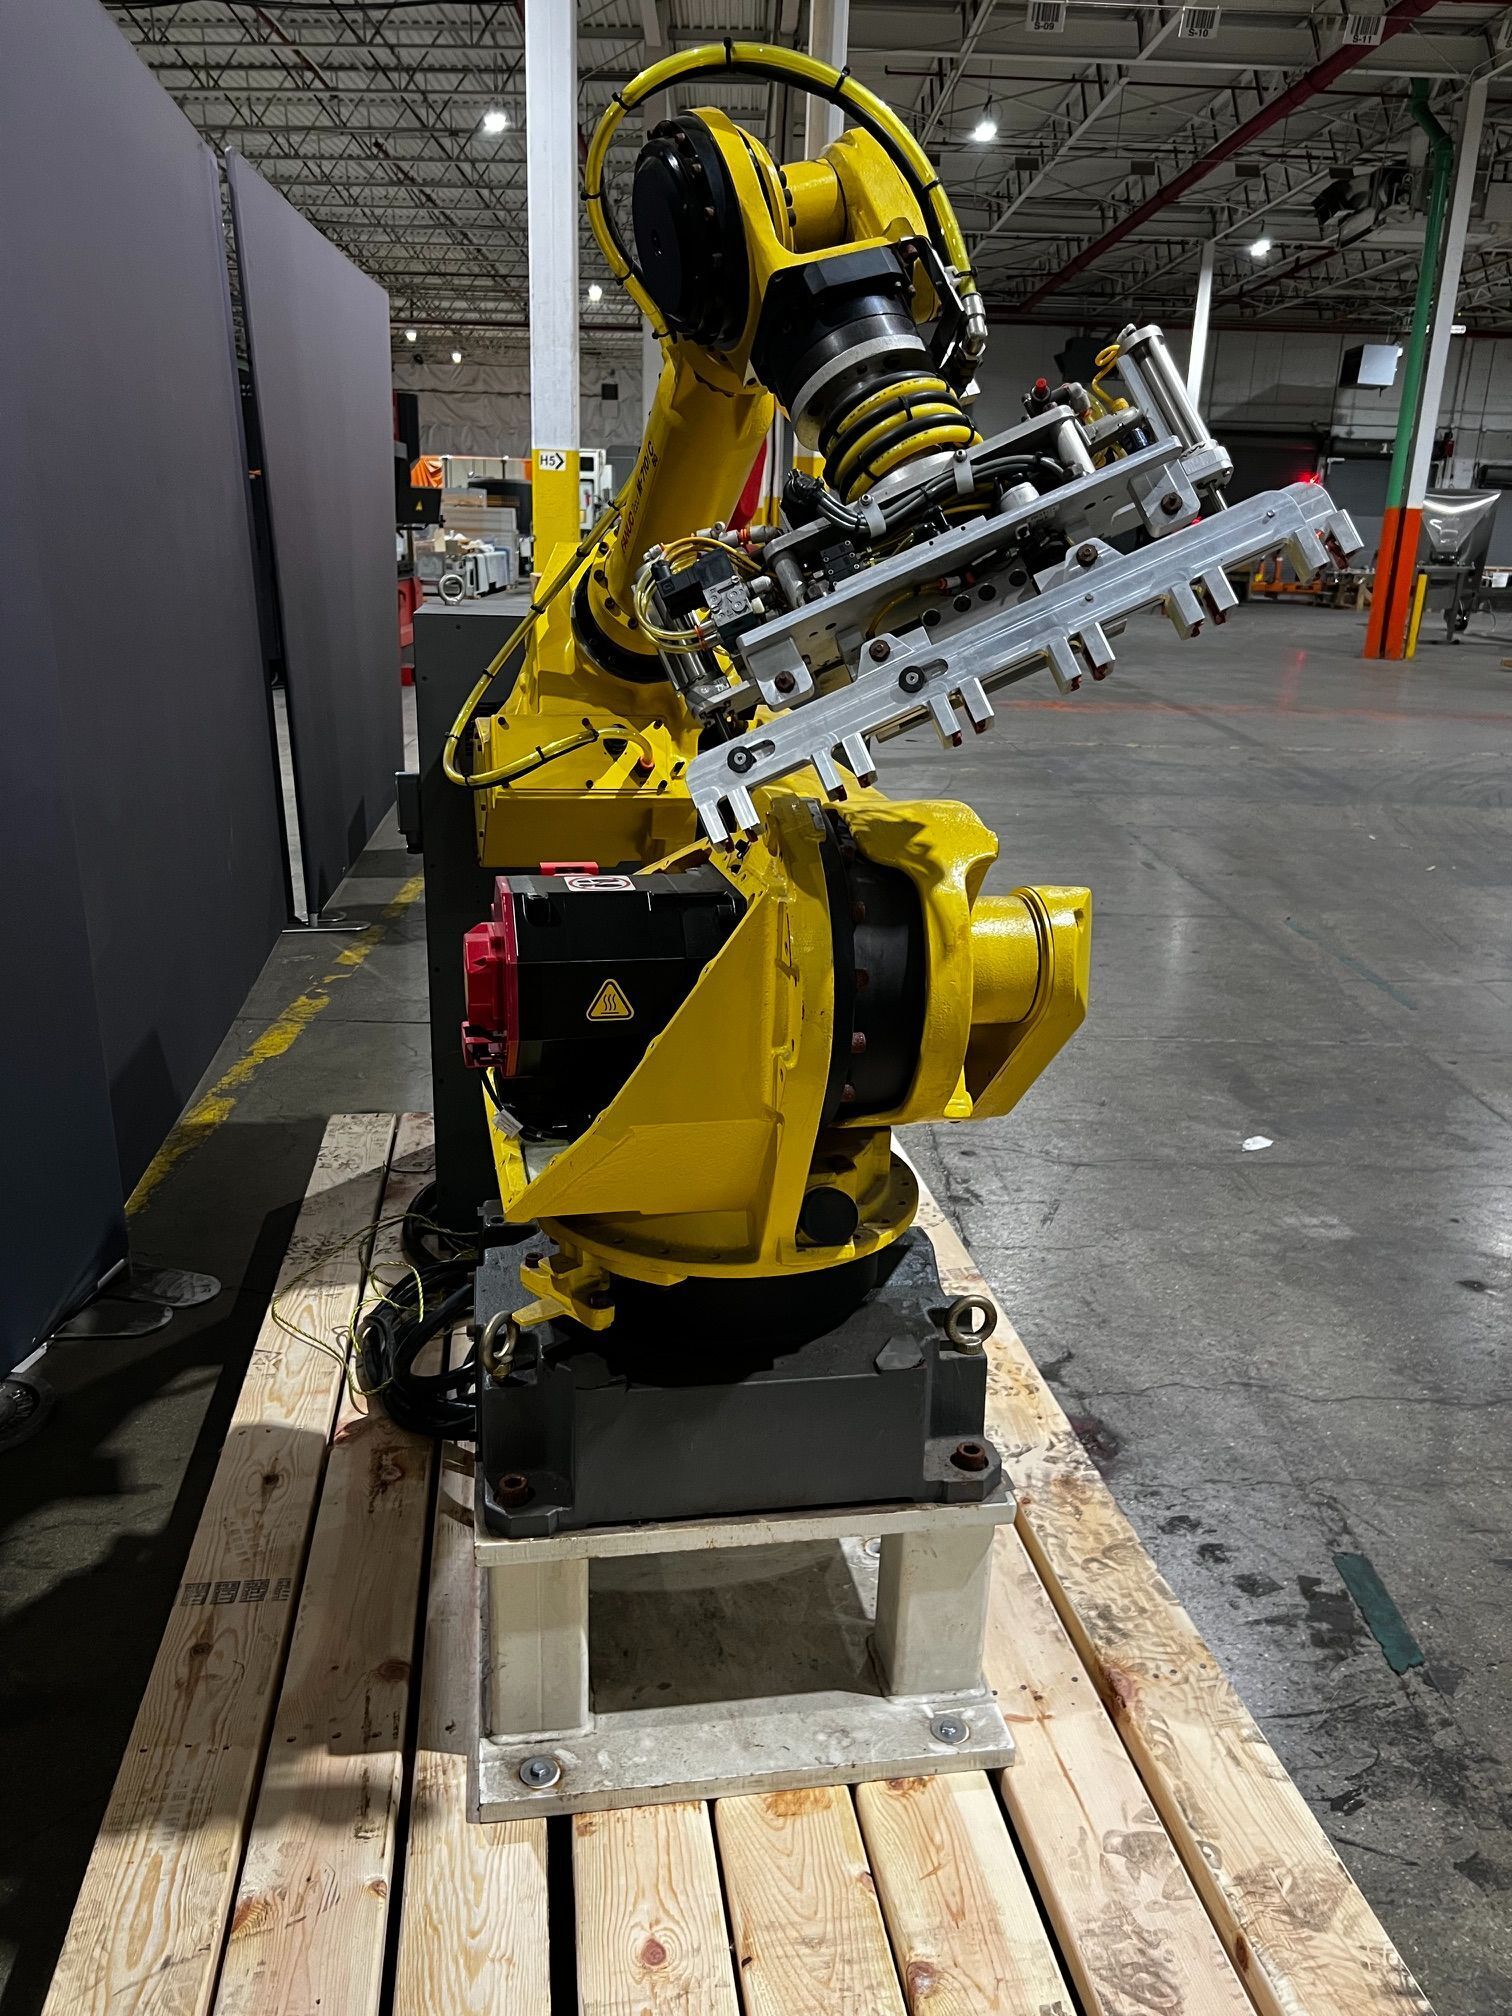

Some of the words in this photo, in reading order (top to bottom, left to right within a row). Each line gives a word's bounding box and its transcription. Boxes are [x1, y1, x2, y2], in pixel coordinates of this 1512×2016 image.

[1034, 22, 1055, 31] S-09
[1188, 28, 1209, 38] S-10
[1352, 35, 1372, 44] S-11
[540, 454, 556, 466] H5
